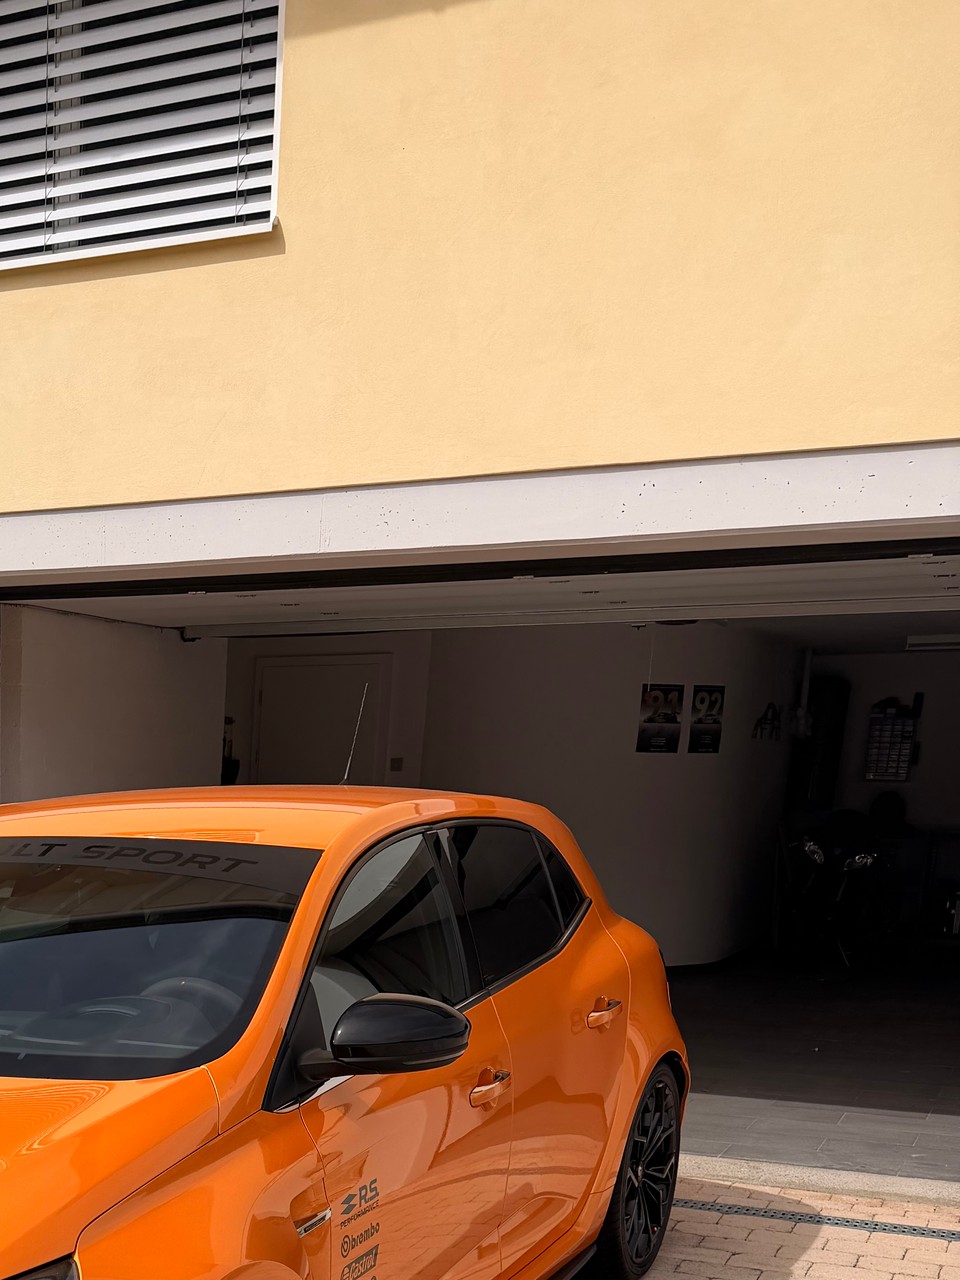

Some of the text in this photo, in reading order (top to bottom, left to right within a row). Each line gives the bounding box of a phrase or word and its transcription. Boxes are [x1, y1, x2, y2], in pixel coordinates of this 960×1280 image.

[695, 691, 722, 716] 92
[73, 845, 258, 873] SPORT
[340, 1200, 379, 1229] PERFORMANCE
[350, 1222, 380, 1250] brembo
[349, 1257, 376, 1279] Castrol
